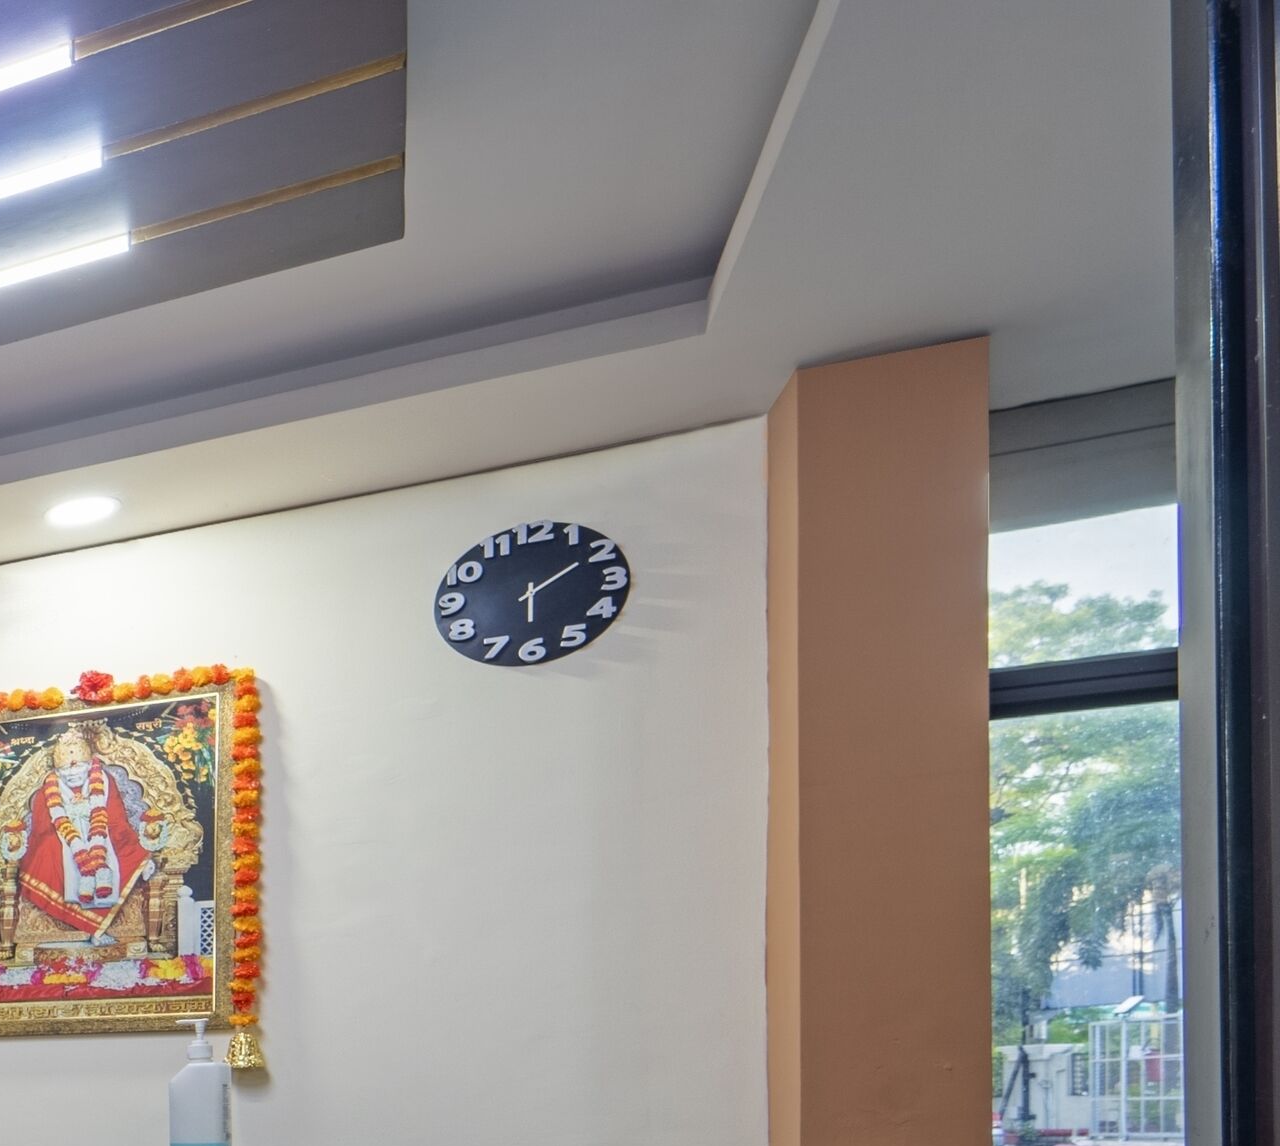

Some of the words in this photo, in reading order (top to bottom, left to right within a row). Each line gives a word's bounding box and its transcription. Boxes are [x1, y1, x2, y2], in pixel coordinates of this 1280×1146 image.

[512, 519, 554, 545] 12
[563, 524, 579, 545] 1
[480, 534, 511, 559] 11
[588, 538, 617, 563] 2
[446, 561, 484, 587] 10
[601, 566, 628, 591] 3
[438, 592, 465, 616] 9
[586, 596, 617, 619] 4
[448, 618, 475, 642] 8
[560, 623, 587, 648] 5
[483, 635, 510, 660] 7
[518, 637, 546, 663] 6
